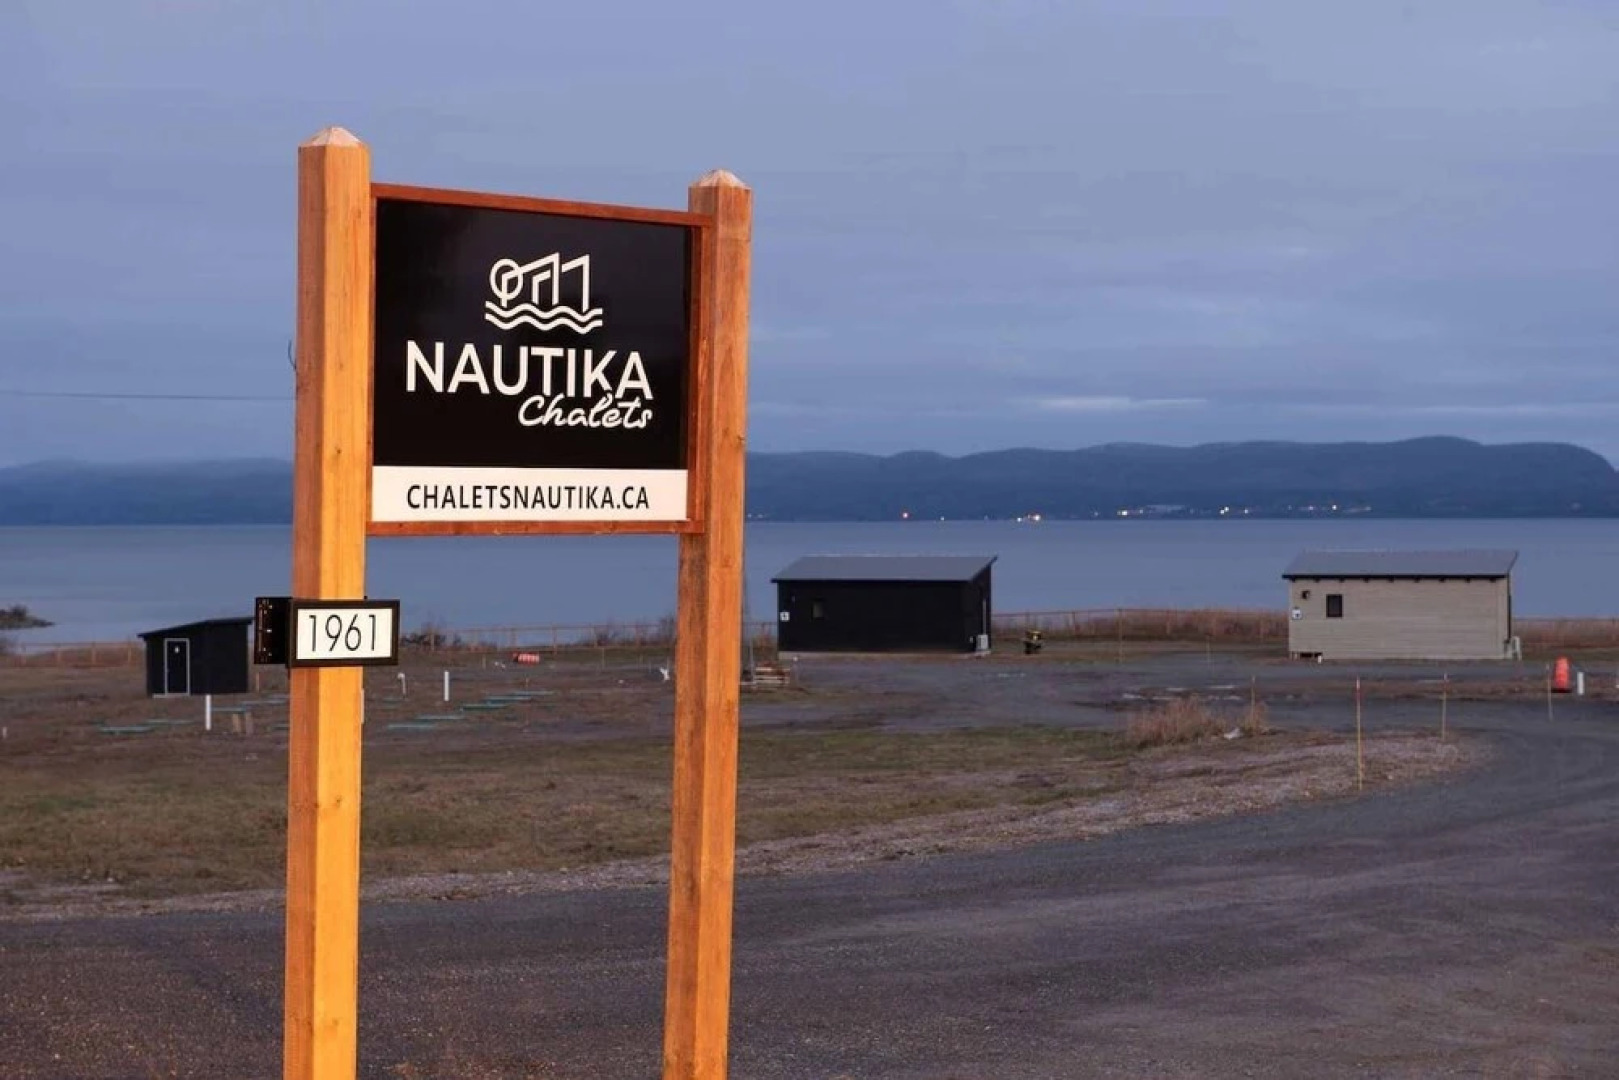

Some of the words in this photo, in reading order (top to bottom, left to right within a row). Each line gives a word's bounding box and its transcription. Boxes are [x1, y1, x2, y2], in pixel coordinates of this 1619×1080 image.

[407, 341, 653, 399] NAUTIKA
[518, 393, 653, 428] Chalets
[407, 485, 649, 509] CHALETSNAUTIKA.CA
[309, 614, 376, 651] 1961
